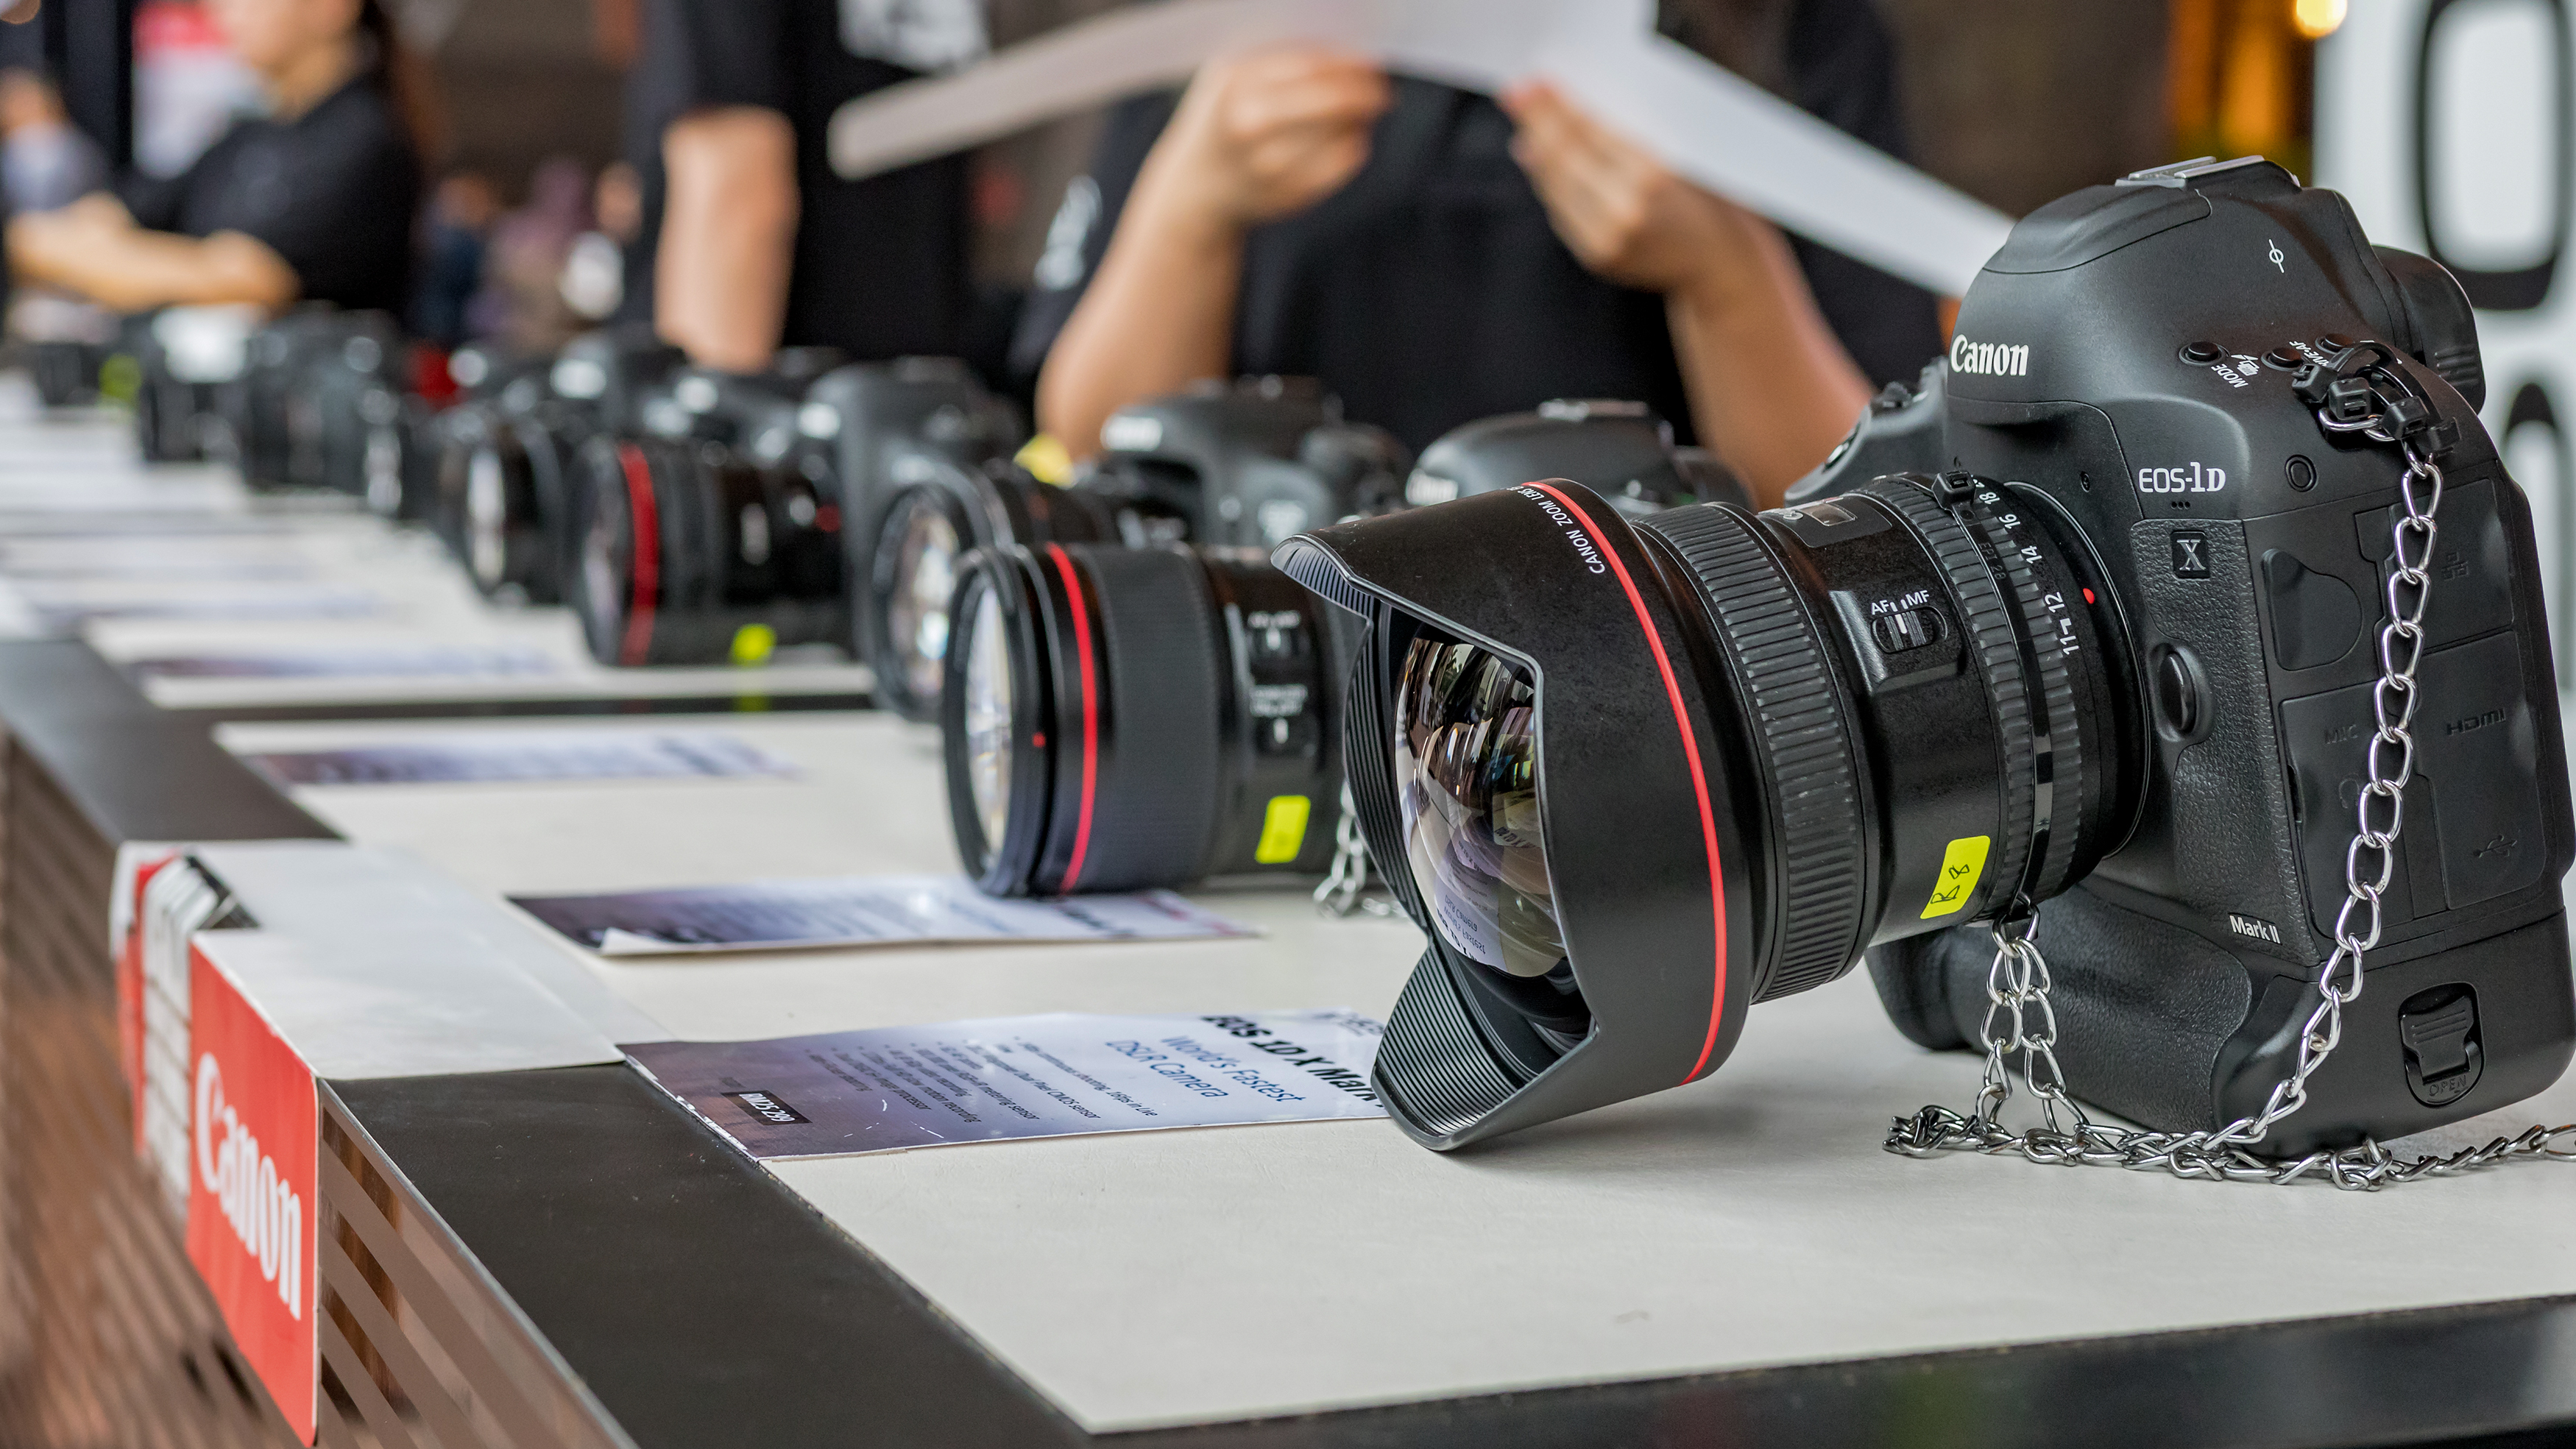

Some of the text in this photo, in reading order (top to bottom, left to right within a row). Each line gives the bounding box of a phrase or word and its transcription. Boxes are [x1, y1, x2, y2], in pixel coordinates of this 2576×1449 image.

[1950, 333, 2029, 376] Canon
[2211, 364, 2249, 389] MODE
[2139, 461, 2226, 493] EOS-1D
[1517, 488, 1545, 500] LENS
[1979, 492, 2000, 505] 18
[1538, 500, 1573, 526] ZOOM
[1998, 514, 2021, 529] 16
[1566, 529, 1606, 574] CANON
[2021, 545, 2042, 564] 14
[2176, 539, 2207, 571] X
[1871, 599, 1889, 615] AF
[1905, 589, 1930, 606] MF
[2045, 592, 2065, 613] 12
[2059, 635, 2080, 655] 11
[2446, 709, 2506, 736] HDMI
[2229, 915, 2281, 944] Mark II
[1249, 1040, 1308, 1055] 1D
[1284, 1057, 1335, 1066] X
[1150, 1063, 1228, 1097] Camera
[1222, 1070, 1306, 1102] Fastest
[2429, 1074, 2467, 1097] OPEN
[888, 1089, 933, 1110] processor
[1047, 1091, 1080, 1105] CMOS
[1069, 1105, 1101, 1119] sensor
[760, 1110, 796, 1122] 299
[941, 1102, 982, 1123] recording
[1008, 1105, 1040, 1119] sensor
[1136, 1108, 1158, 1116] Live
[195, 1051, 302, 1321] Canon
